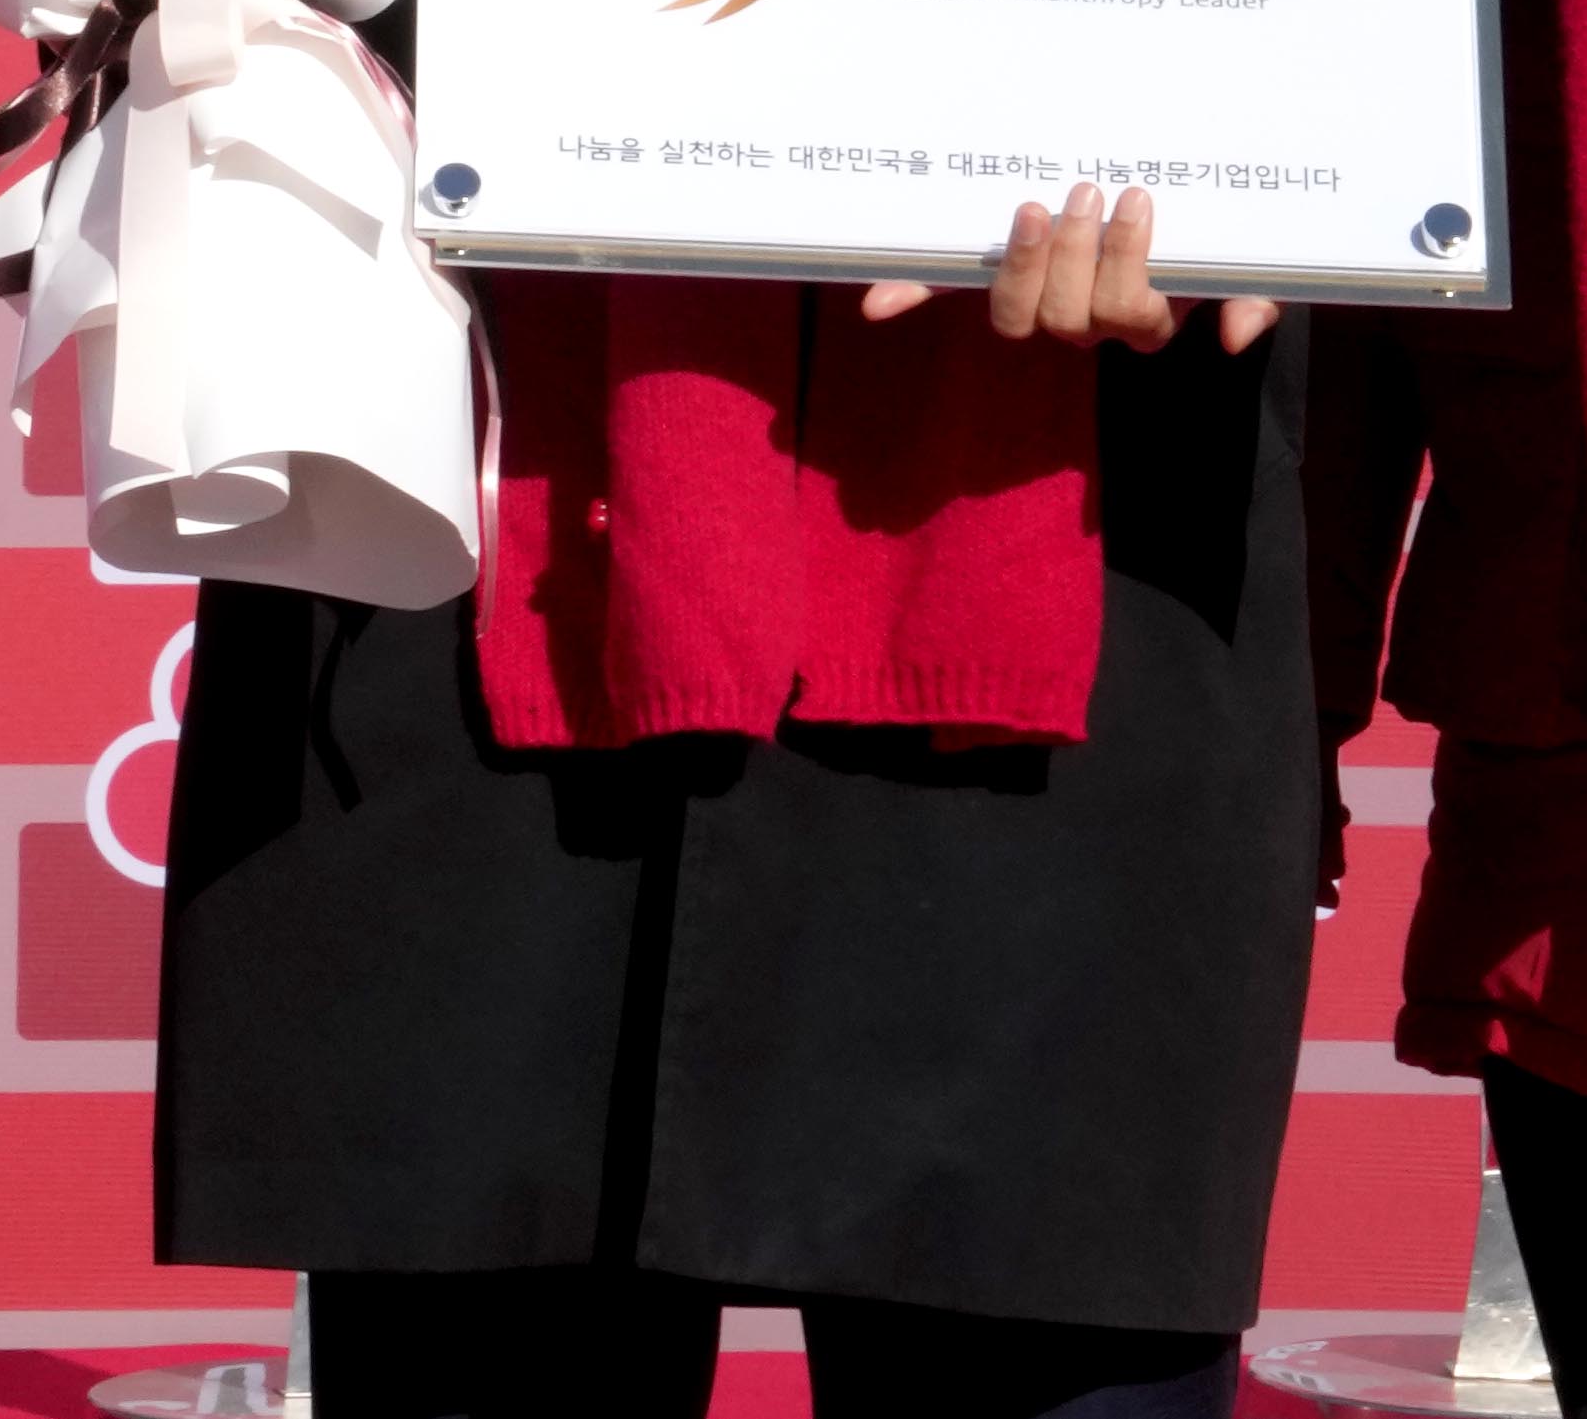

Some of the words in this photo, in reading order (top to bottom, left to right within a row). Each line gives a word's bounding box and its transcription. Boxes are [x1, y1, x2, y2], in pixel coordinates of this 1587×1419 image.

[559, 135, 645, 163] 나눔을
[659, 139, 774, 168] 실천하는
[788, 145, 933, 175] 대한민국을
[947, 152, 1064, 181] 대표하는
[1077, 157, 1342, 193] 나눔명문기업입니다
